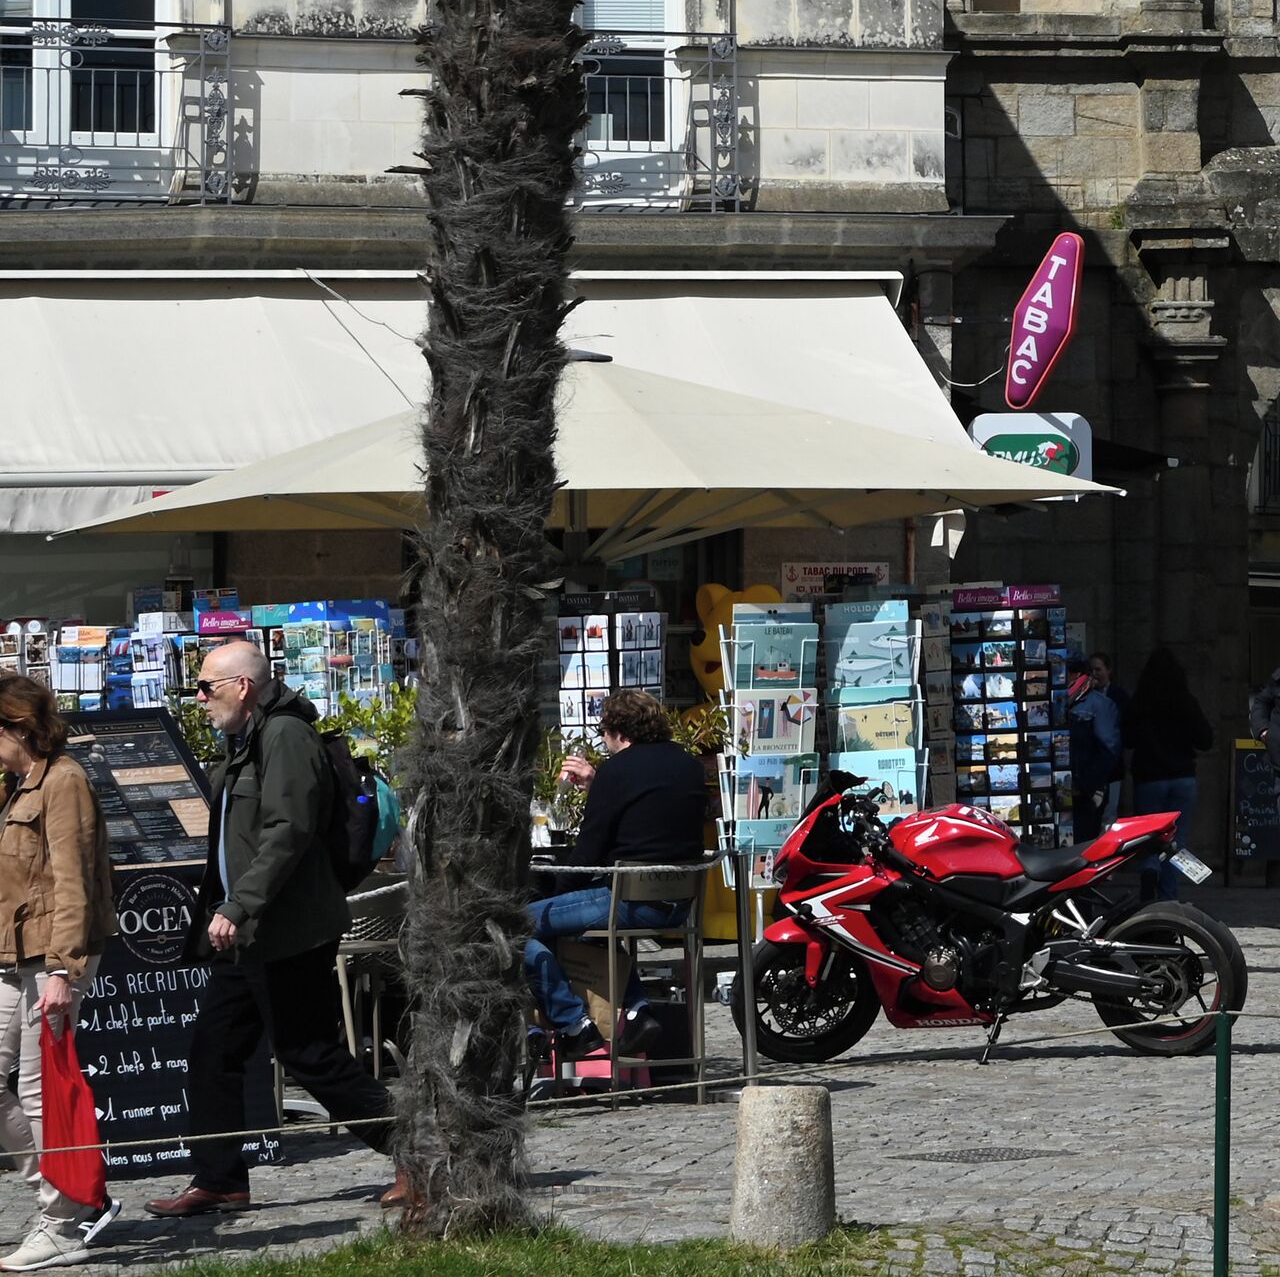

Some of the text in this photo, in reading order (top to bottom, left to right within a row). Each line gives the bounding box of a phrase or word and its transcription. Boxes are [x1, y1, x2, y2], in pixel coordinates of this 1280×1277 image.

[1011, 255, 1067, 385] TABAC
[803, 566, 829, 577] TABAC
[847, 566, 869, 576] PORT
[619, 594, 640, 603] INSTANT
[843, 603, 889, 614] HOLIDAYS
[765, 626, 793, 635] LE BATEAU
[763, 743, 798, 751] BRONZETTE
[1235, 847, 1252, 856] that
[86, 967, 212, 999] OUS RECRUTON
[106, 1003, 129, 1035] chef
[132, 1000, 144, 1027] de
[147, 998, 176, 1032] partie
[915, 1017, 987, 1027] HONDA
[99, 1047, 189, 1075] 2 chefs de rang
[122, 1106, 156, 1120] runner
[160, 1103, 182, 1121] pour
[262, 1133, 279, 1149] ton
[101, 1139, 129, 1166] Viens
[132, 1151, 153, 1163] nous
